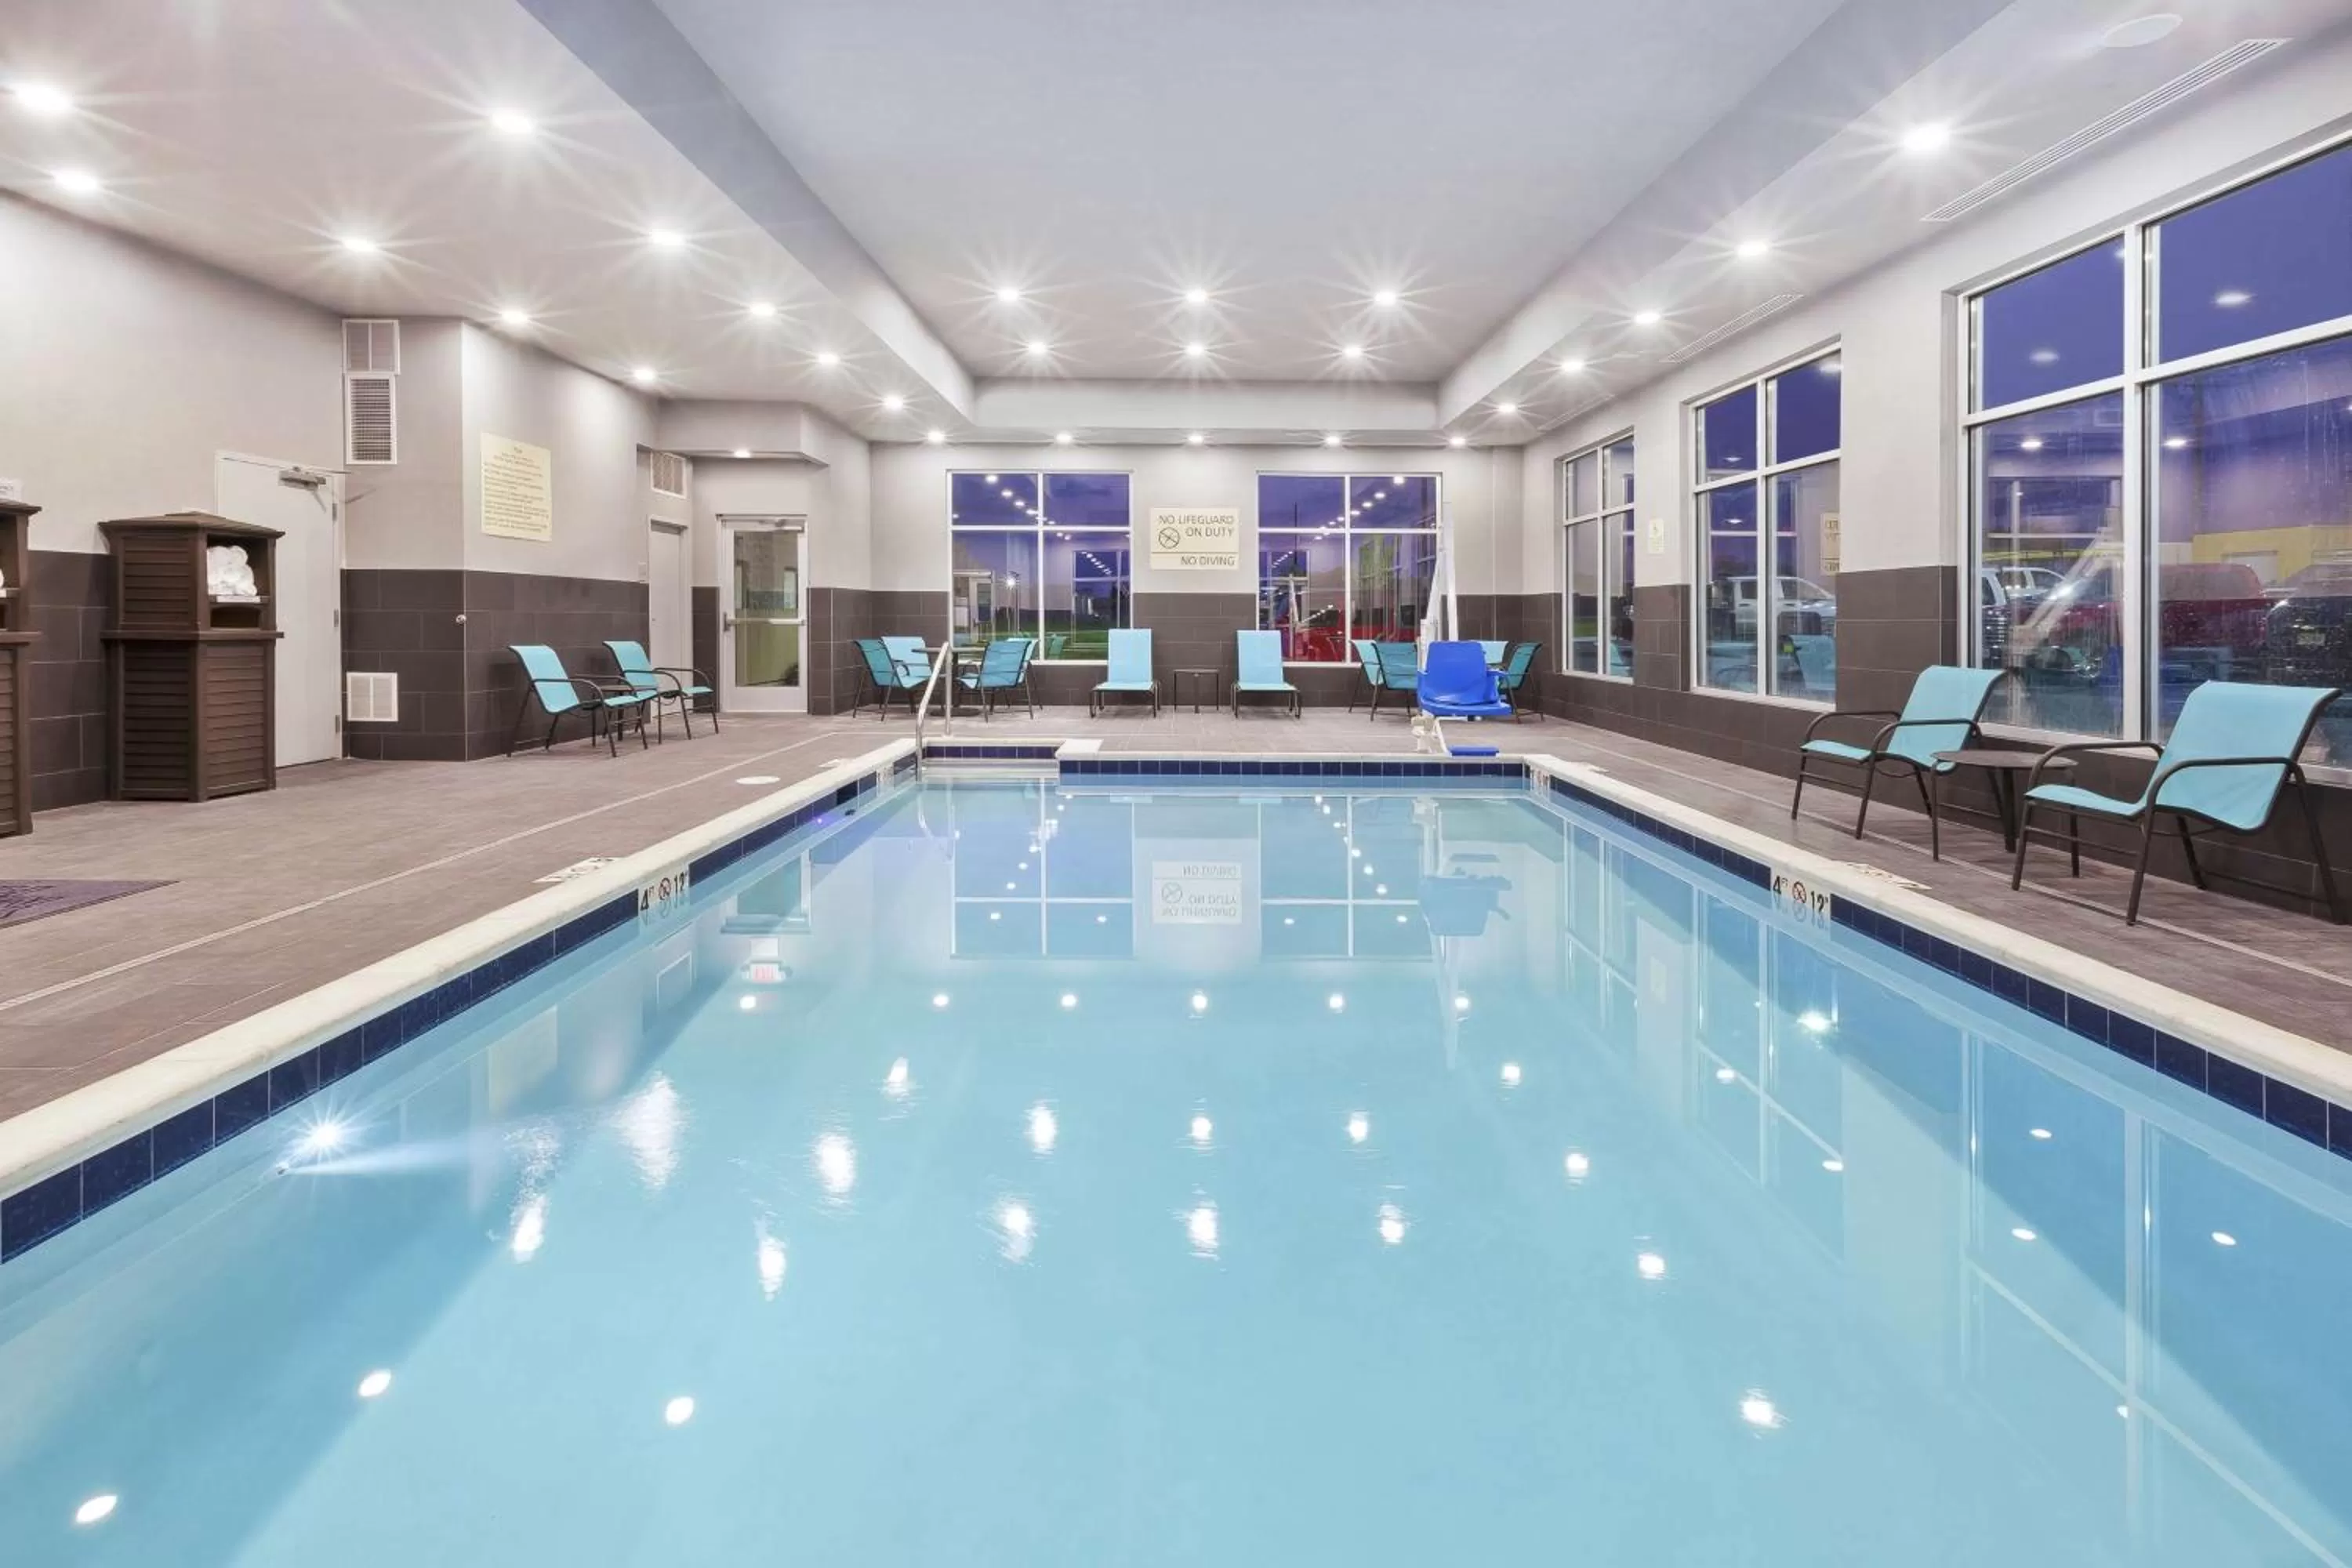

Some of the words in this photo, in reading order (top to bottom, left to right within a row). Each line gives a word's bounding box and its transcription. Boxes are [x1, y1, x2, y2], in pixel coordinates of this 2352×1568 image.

[1159, 514, 1175, 524] NO
[1178, 514, 1234, 524] LIFEGUARD
[1185, 526, 1202, 537] ON
[1205, 526, 1233, 537] DUTY
[1181, 556, 1197, 565] NO
[1199, 556, 1236, 566] DIVING
